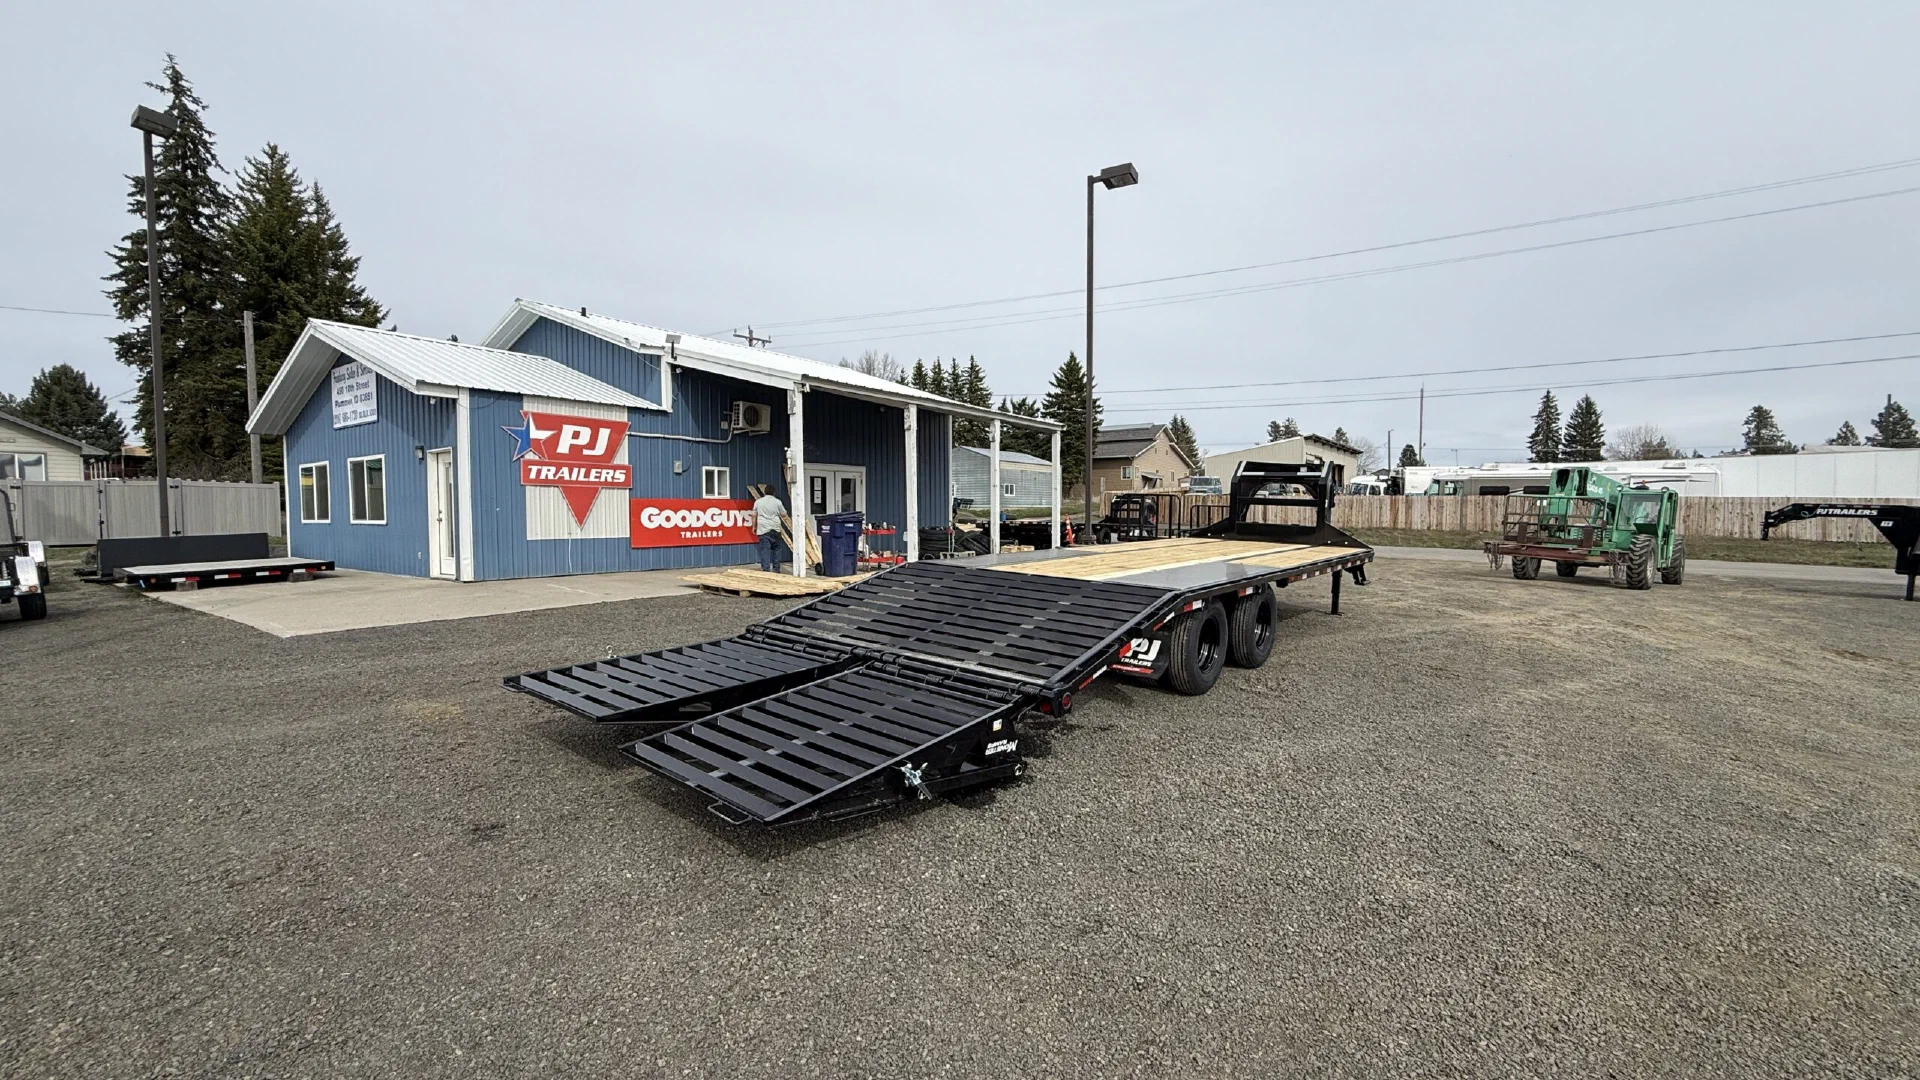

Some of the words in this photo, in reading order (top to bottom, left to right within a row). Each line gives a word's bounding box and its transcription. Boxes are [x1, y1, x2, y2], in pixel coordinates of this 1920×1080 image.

[355, 380, 370, 390] Street
[555, 423, 611, 456] PJ
[527, 464, 627, 483] TRAILERS
[640, 506, 753, 529] GOODGUYS
[1828, 508, 1878, 516] TRAILERS
[680, 530, 723, 539] TRAILERS
[1121, 638, 1162, 661] PJ
[1121, 657, 1152, 667] TRAILERS
